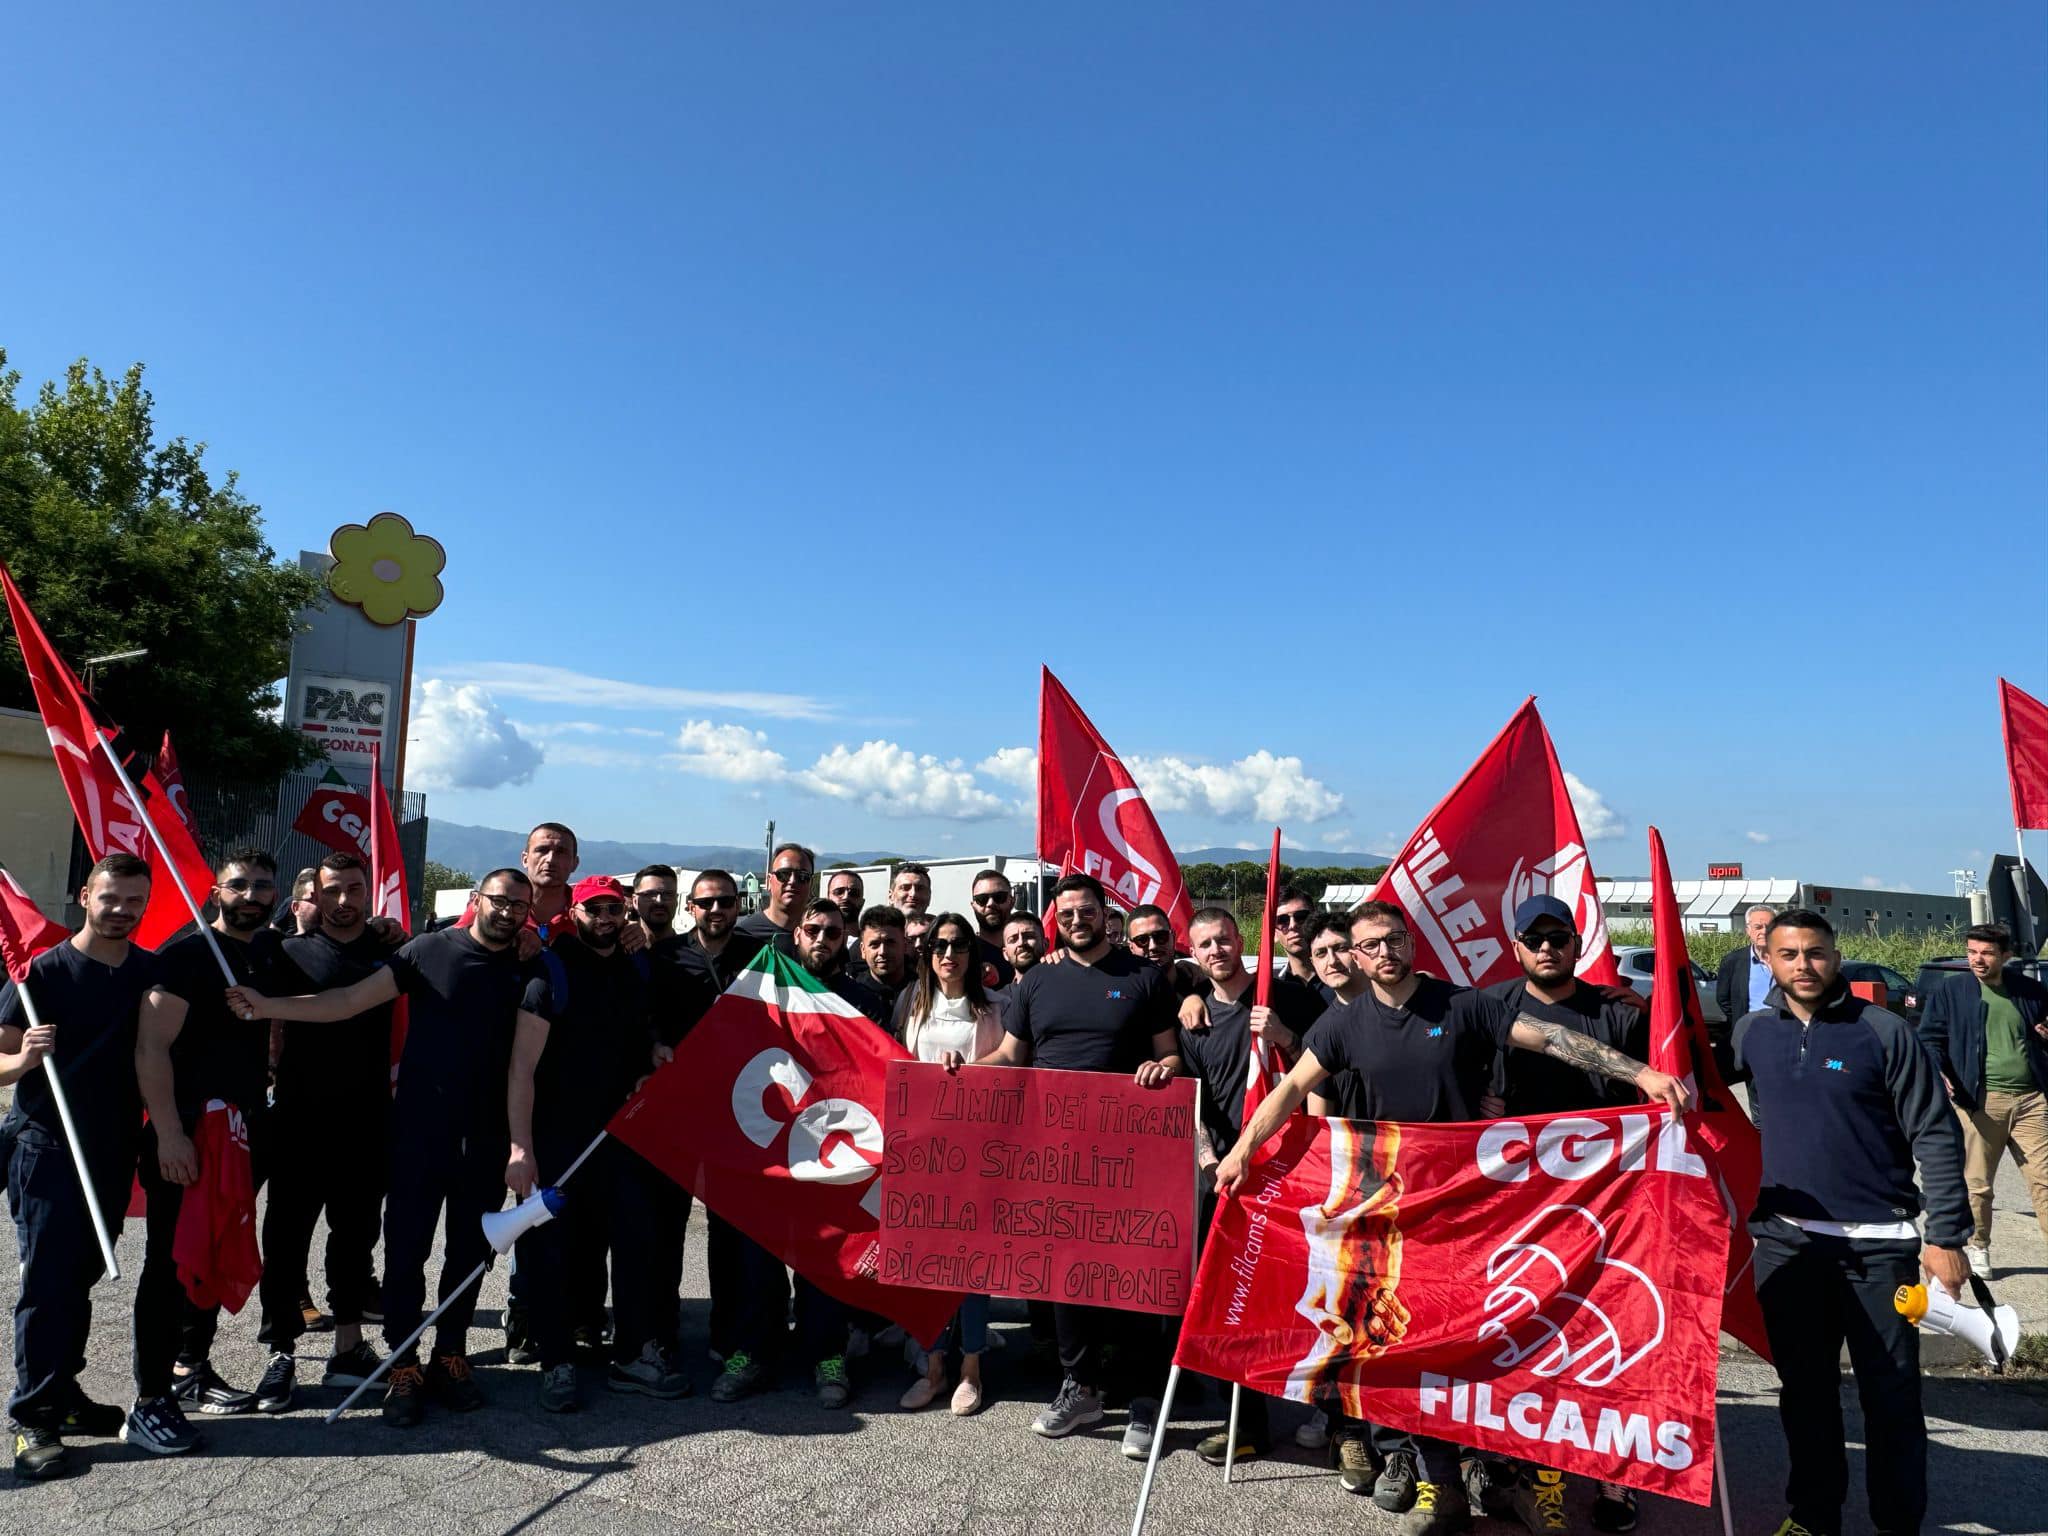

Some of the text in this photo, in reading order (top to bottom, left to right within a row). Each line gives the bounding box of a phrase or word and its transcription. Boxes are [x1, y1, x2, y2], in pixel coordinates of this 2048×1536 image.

[304, 686, 385, 726] PAC
[319, 738, 375, 754] CONA
[1083, 848, 1161, 906] FLAI
[1709, 866, 1740, 879] upim
[1407, 826, 1504, 982] ILLEA
[931, 1078, 1025, 1125] LIMITI
[1045, 1092, 1088, 1131] DEI
[887, 1130, 1135, 1188] SONO STABILITI
[1476, 1112, 1707, 1182] CGIL
[885, 1191, 1179, 1249] DALLA RESISTENZA
[1224, 1159, 1289, 1326] www.filcams.cgil.it
[1065, 1262, 1182, 1307] OPPONE
[1420, 1371, 1694, 1471] FILCAMS
